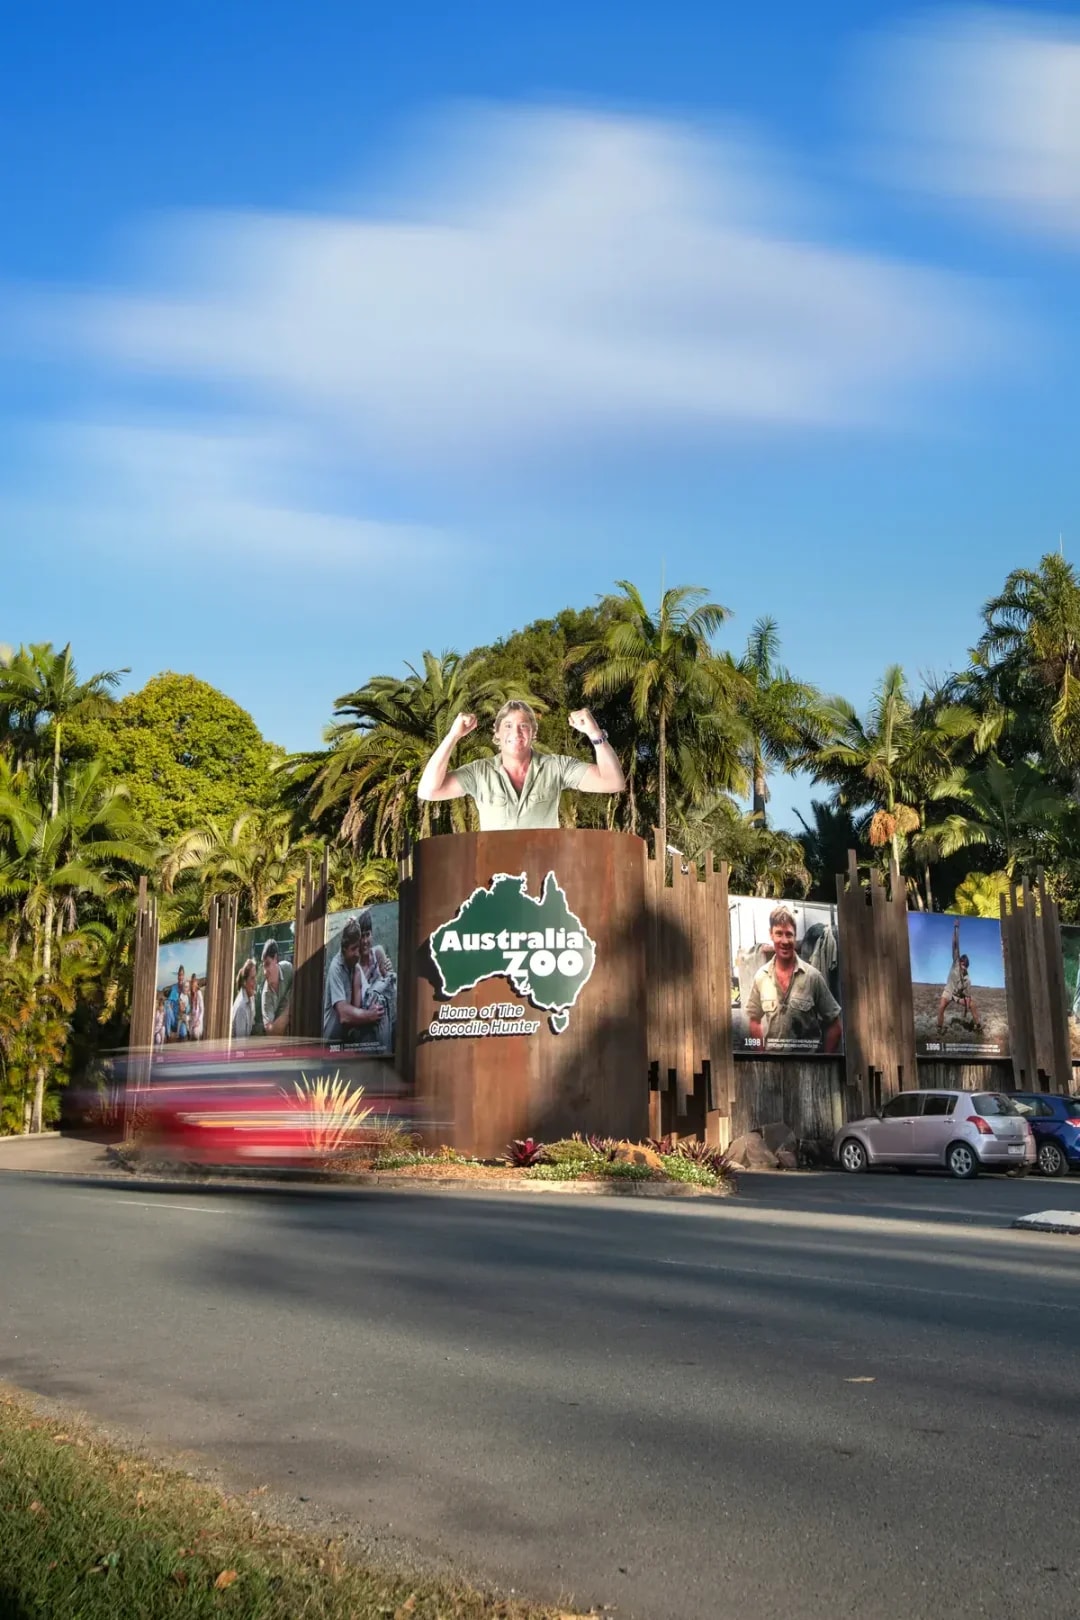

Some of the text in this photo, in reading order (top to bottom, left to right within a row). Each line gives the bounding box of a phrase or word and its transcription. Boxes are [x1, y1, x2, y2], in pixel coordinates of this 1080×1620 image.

[440, 928, 584, 951] Australia
[440, 1004, 523, 1019] Home of The
[430, 1020, 538, 1035] Crocodile Hunter
